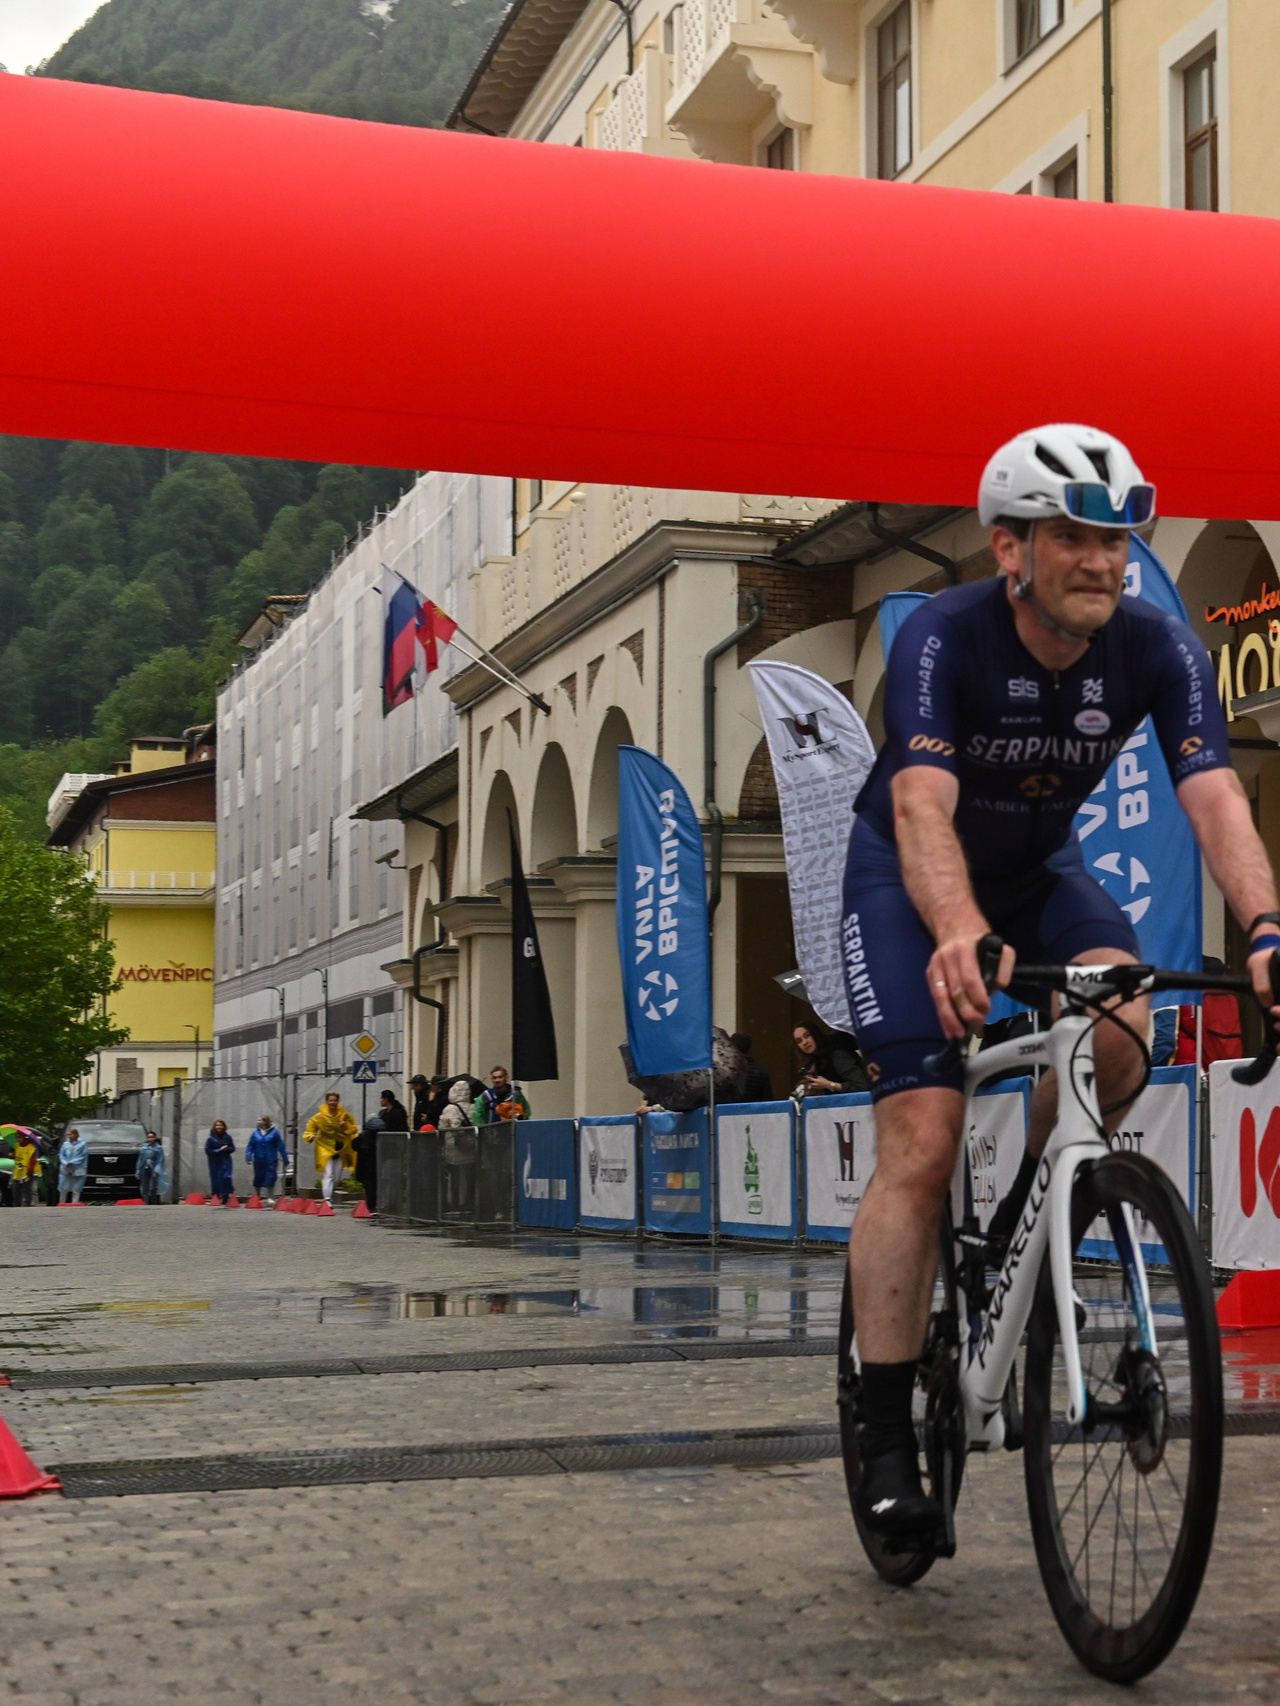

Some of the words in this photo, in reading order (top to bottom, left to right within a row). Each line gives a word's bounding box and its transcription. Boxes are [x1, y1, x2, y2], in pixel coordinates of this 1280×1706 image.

[918, 635, 942, 719] ПАНАВТО
[117, 963, 214, 983] MÖVENPIC
[842, 912, 885, 1028] SERPANTIN
[976, 1155, 1051, 1371] PINARELLO
